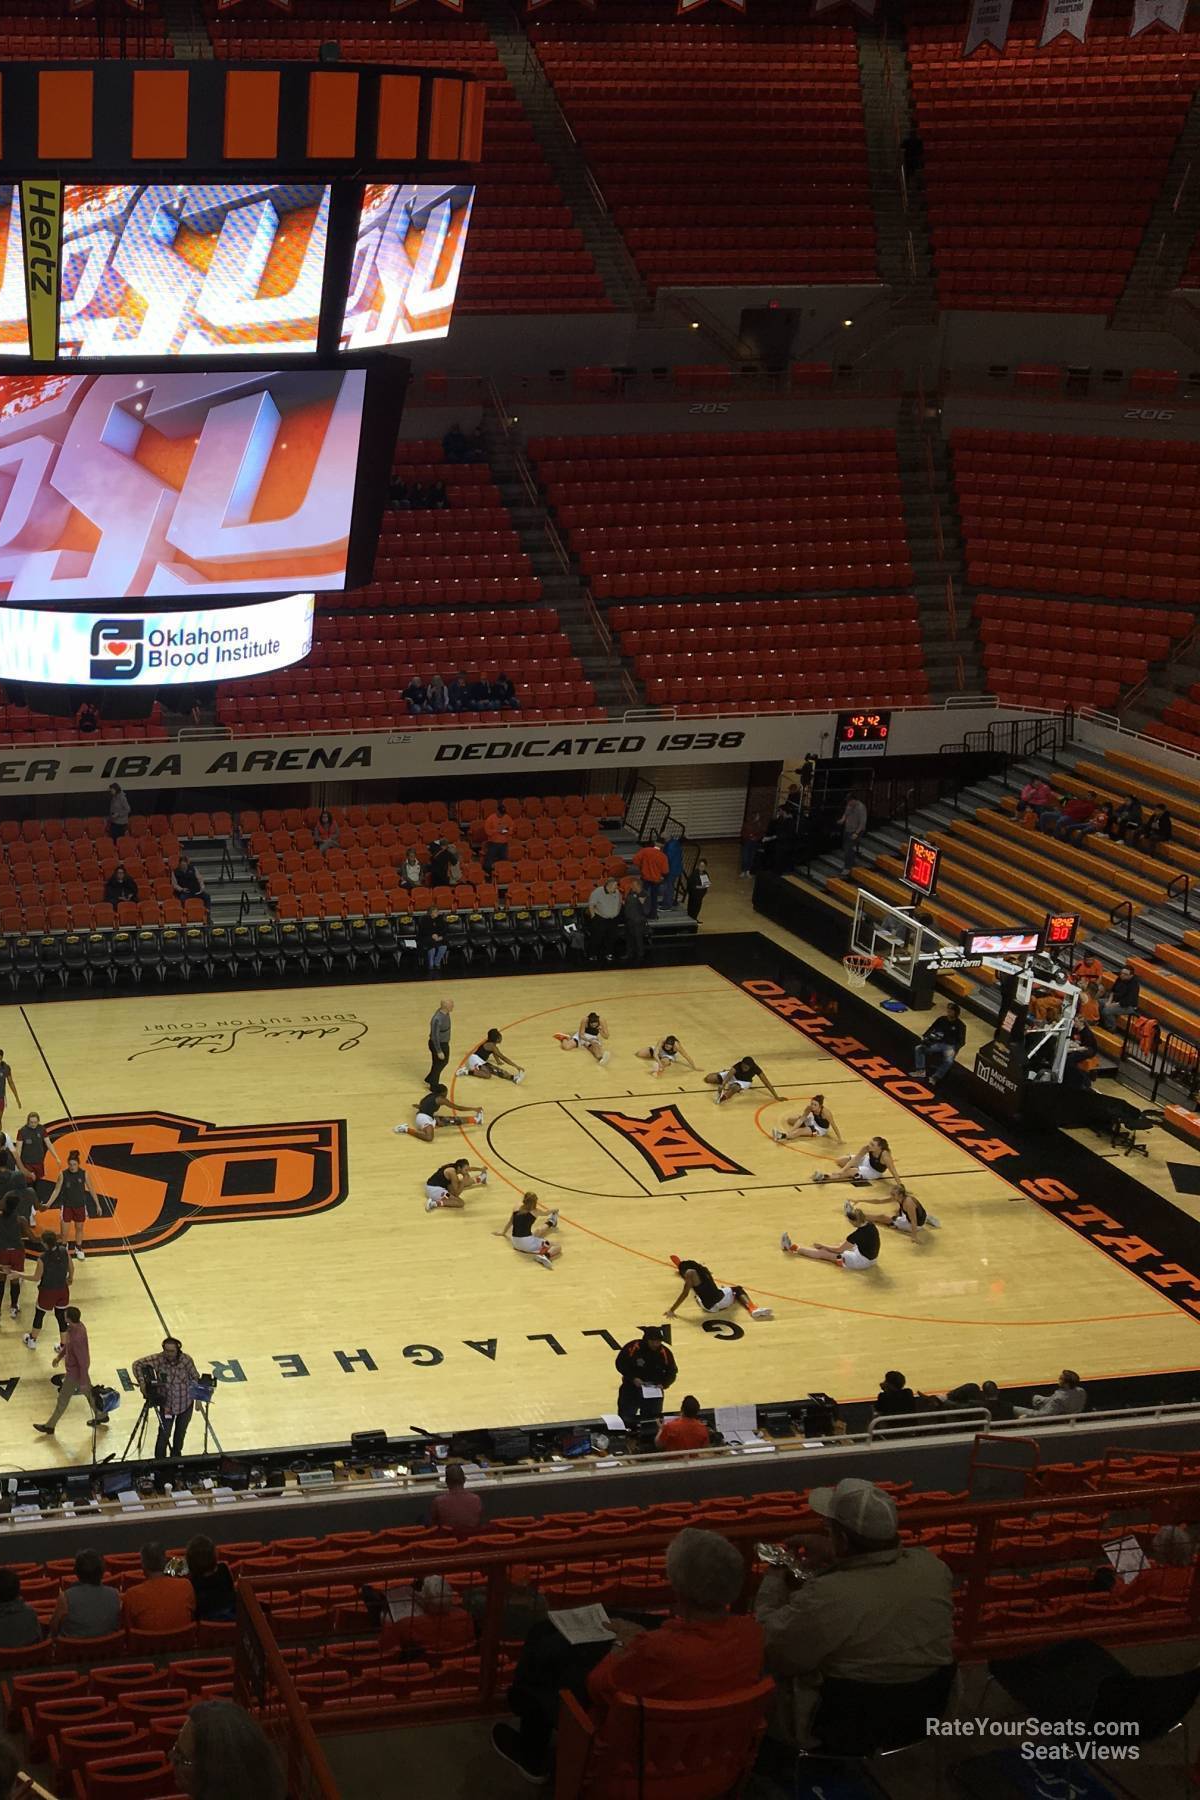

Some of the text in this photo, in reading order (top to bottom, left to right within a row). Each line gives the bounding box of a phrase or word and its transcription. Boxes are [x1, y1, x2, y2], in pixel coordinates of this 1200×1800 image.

[28, 187, 56, 296] Hertz
[689, 402, 731, 414] 205
[1123, 408, 1177, 420] 206
[148, 625, 249, 647] Oklahoma
[149, 638, 280, 668] Blood Institute
[205, 745, 372, 774] ARENA
[434, 735, 646, 762] DEDICATED
[656, 731, 746, 751] 1938
[840, 743, 884, 752] HOMELAND
[912, 857, 931, 885] 30
[1052, 927, 1069, 940] 30
[741, 979, 1021, 1162] OKLAHOMA
[988, 1078, 1006, 1094] BANK
